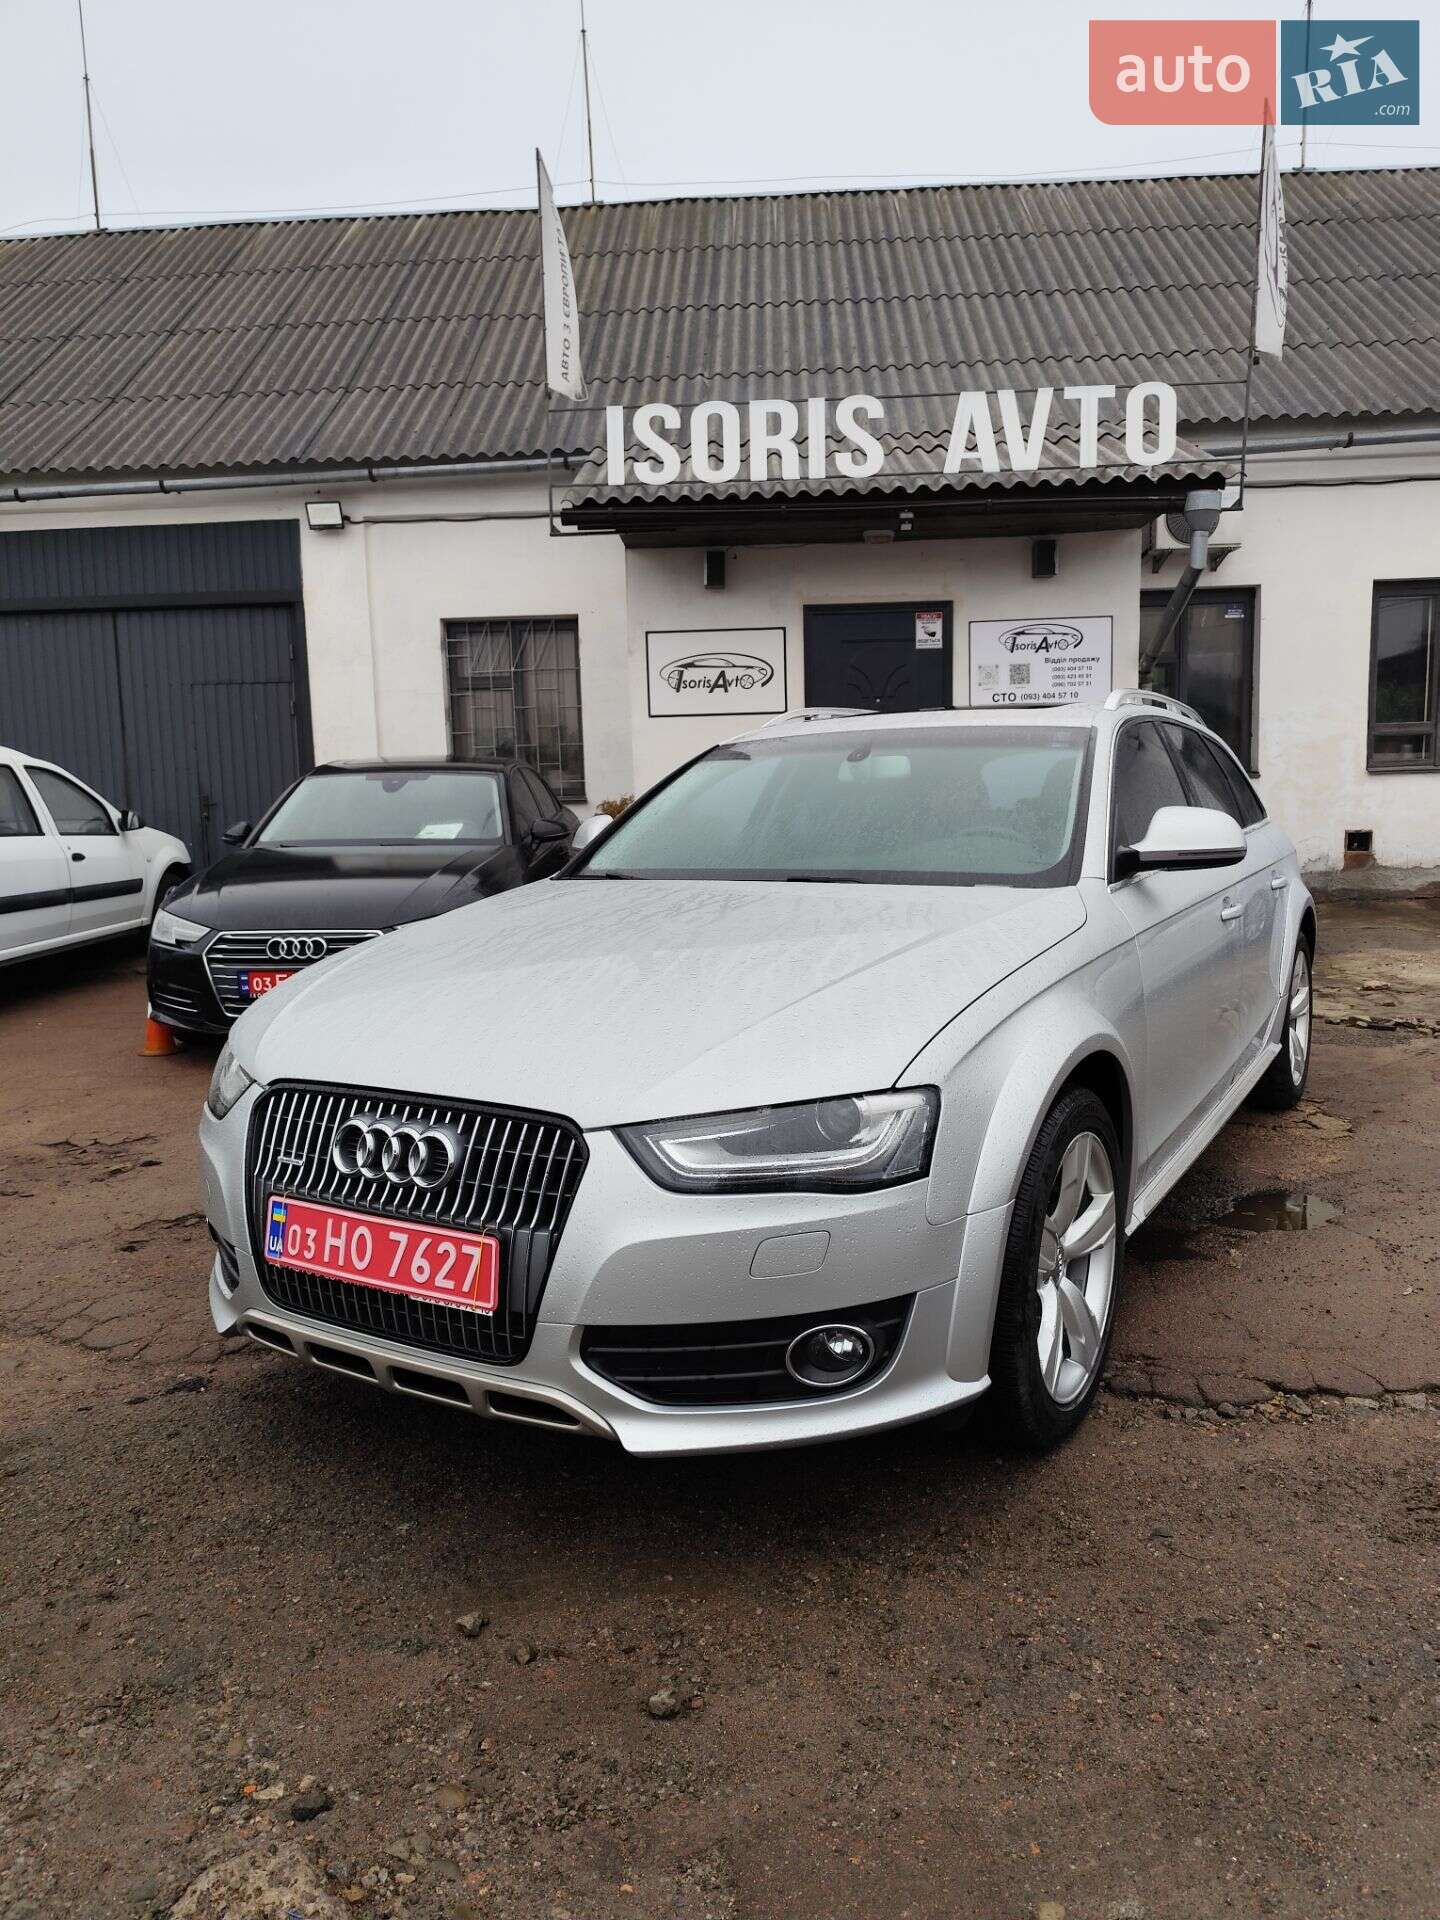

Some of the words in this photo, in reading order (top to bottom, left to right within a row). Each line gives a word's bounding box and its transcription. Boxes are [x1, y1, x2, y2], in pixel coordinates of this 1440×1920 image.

[560, 337, 571, 383] АВТО
[605, 394, 885, 486] ISORIS
[942, 380, 1178, 474] AVTO
[991, 692, 1017, 702] СТО
[1020, 693, 1040, 702] (093)
[1069, 691, 1079, 699] 10
[253, 977, 272, 991] 03
[269, 1235, 283, 1253] UA
[287, 1223, 316, 1259] 03
[322, 1217, 373, 1271] HO
[388, 1231, 481, 1293] 7627
